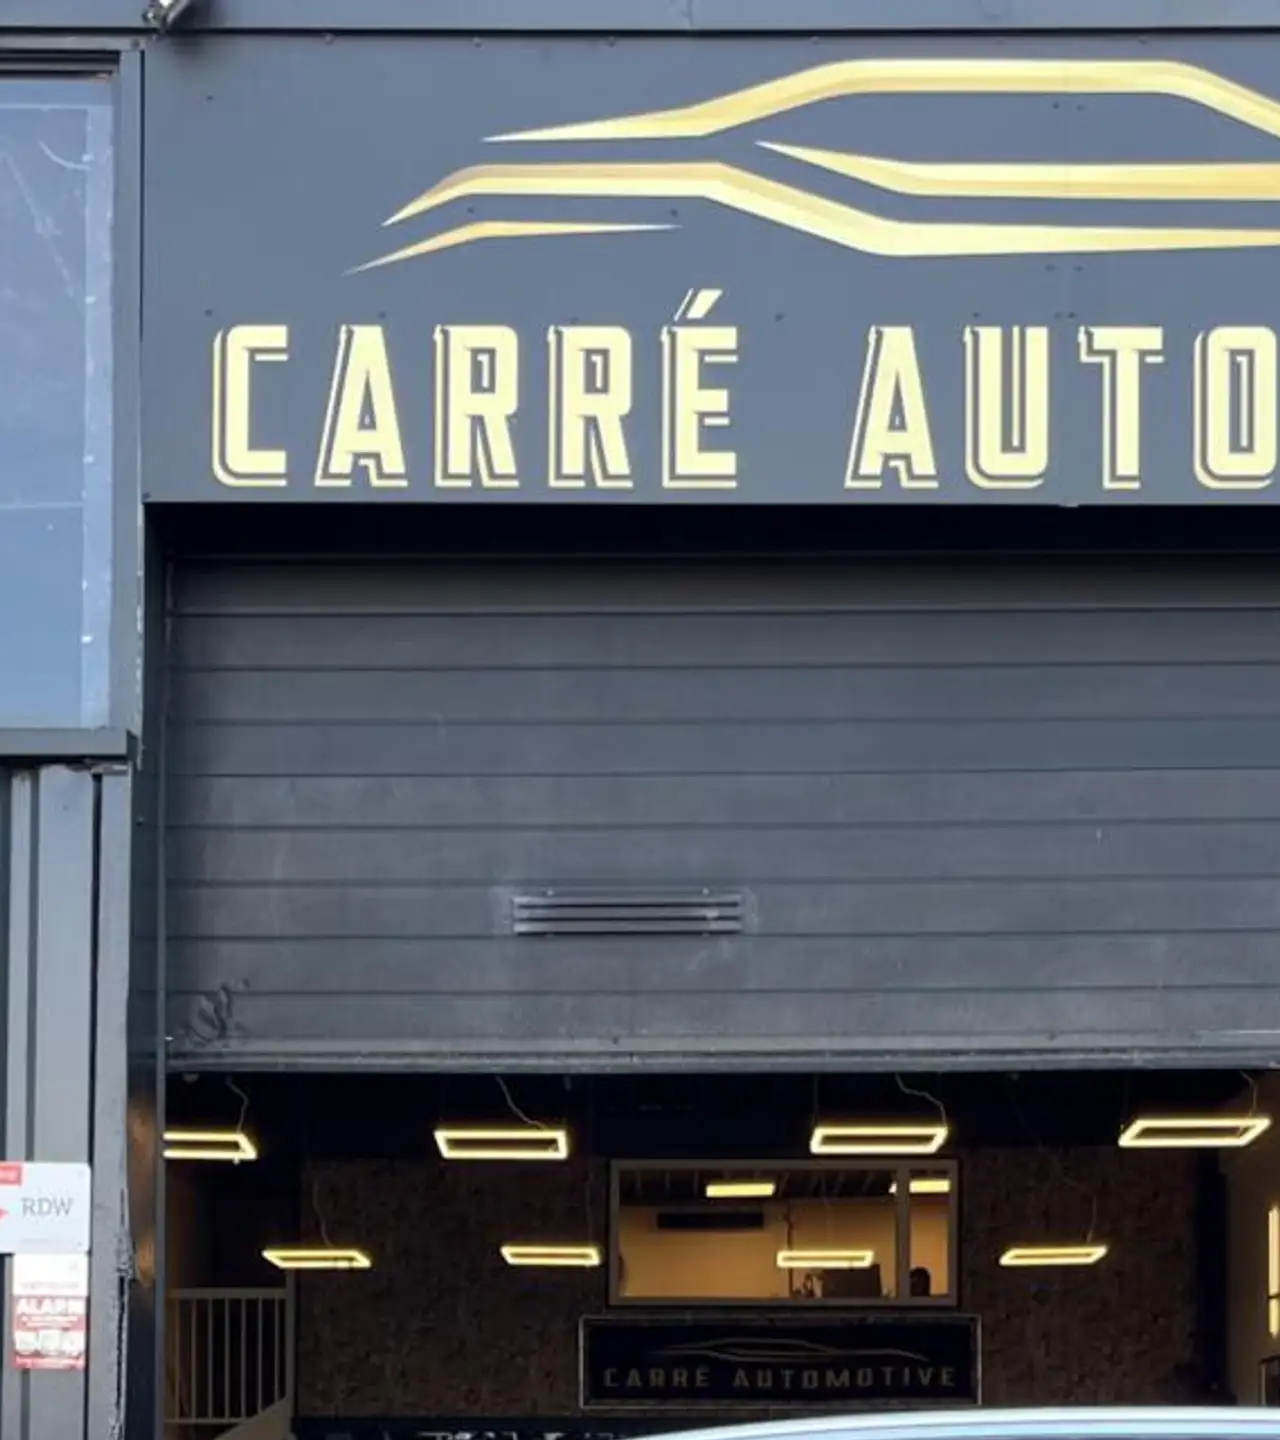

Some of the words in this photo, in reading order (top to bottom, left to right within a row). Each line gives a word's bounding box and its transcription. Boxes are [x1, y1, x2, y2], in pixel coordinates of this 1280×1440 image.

[213, 288, 739, 490] CARRÉ
[22, 1196, 73, 1217] RDW
[732, 1366, 957, 1390] AUTOMOTIVE
